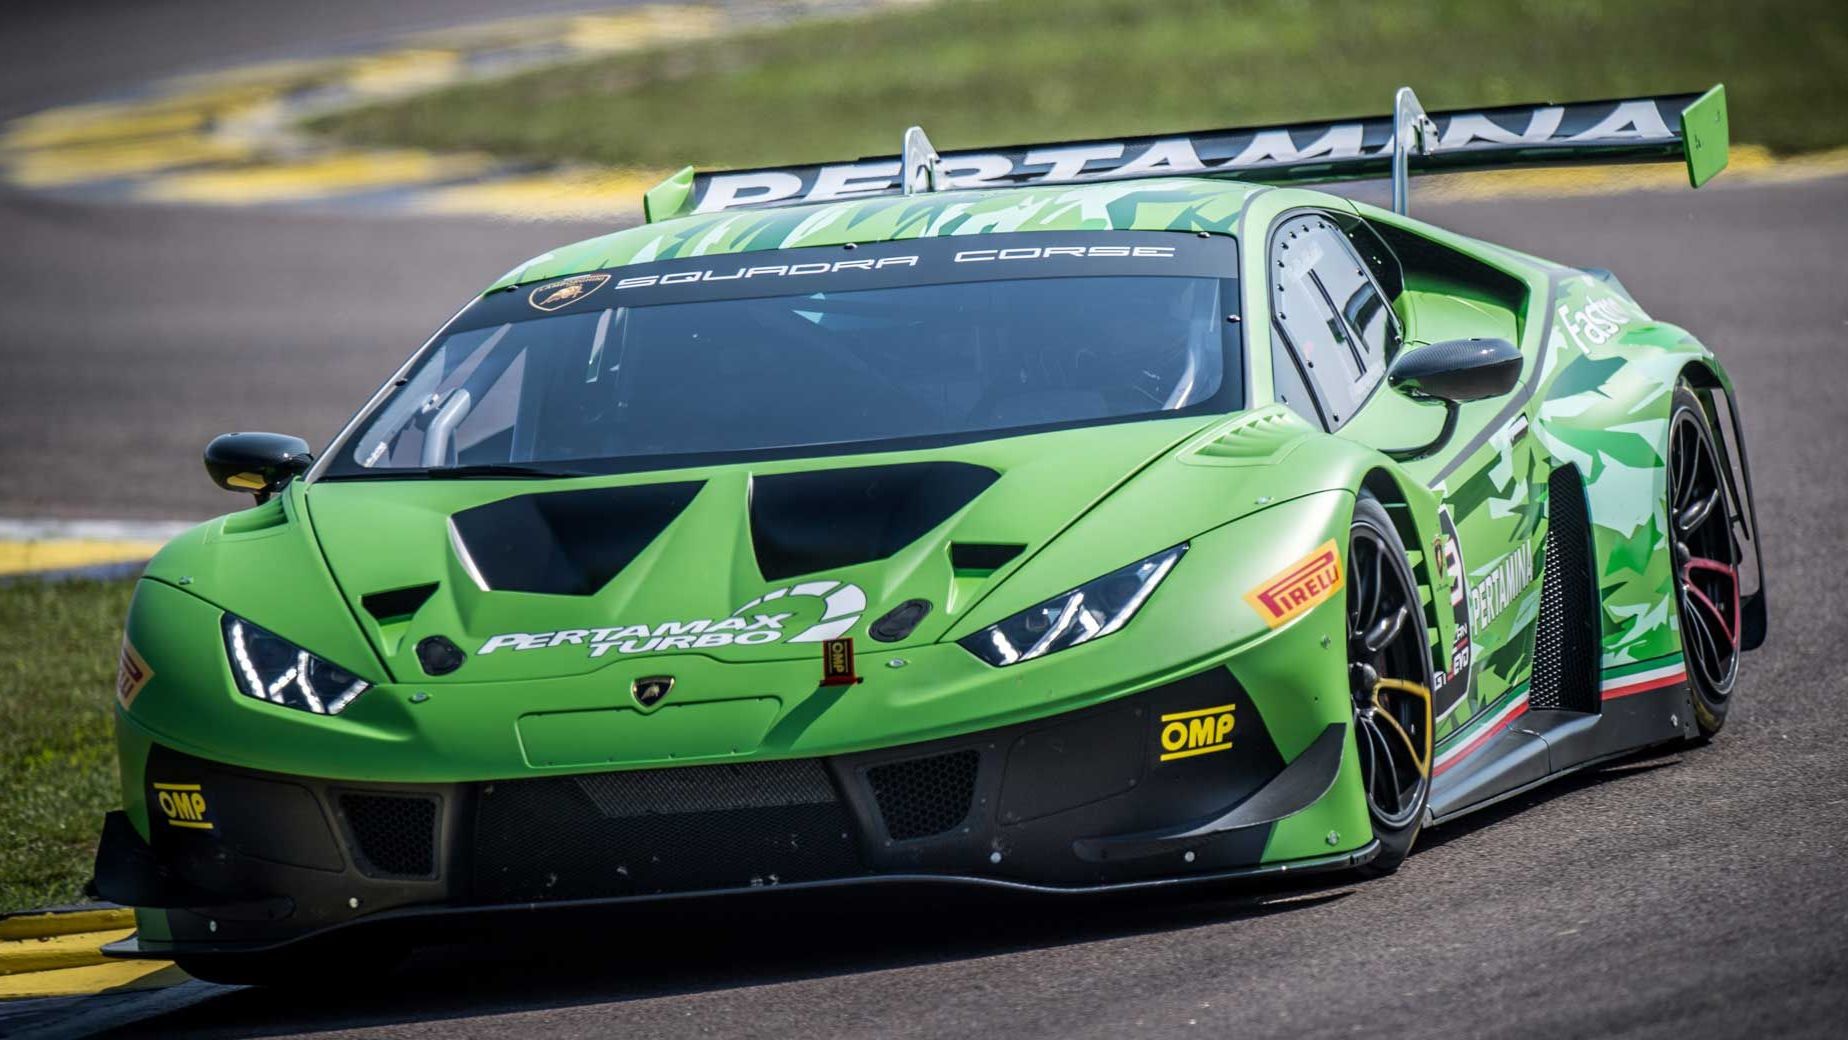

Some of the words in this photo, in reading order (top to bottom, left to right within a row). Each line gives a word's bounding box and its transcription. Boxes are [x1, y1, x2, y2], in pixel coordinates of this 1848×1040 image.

[692, 99, 1674, 214] PERTAMNA
[615, 255, 918, 289] SQUADRA
[954, 246, 1175, 263] CORSE
[1257, 550, 1339, 618] PIRELLI
[1471, 538, 1533, 636] PERTAMINA
[476, 611, 795, 655] PERTAMAX
[588, 629, 783, 658] TURBO
[832, 642, 844, 673] OMP
[1161, 713, 1236, 751] OMP
[158, 791, 207, 820] OMP
